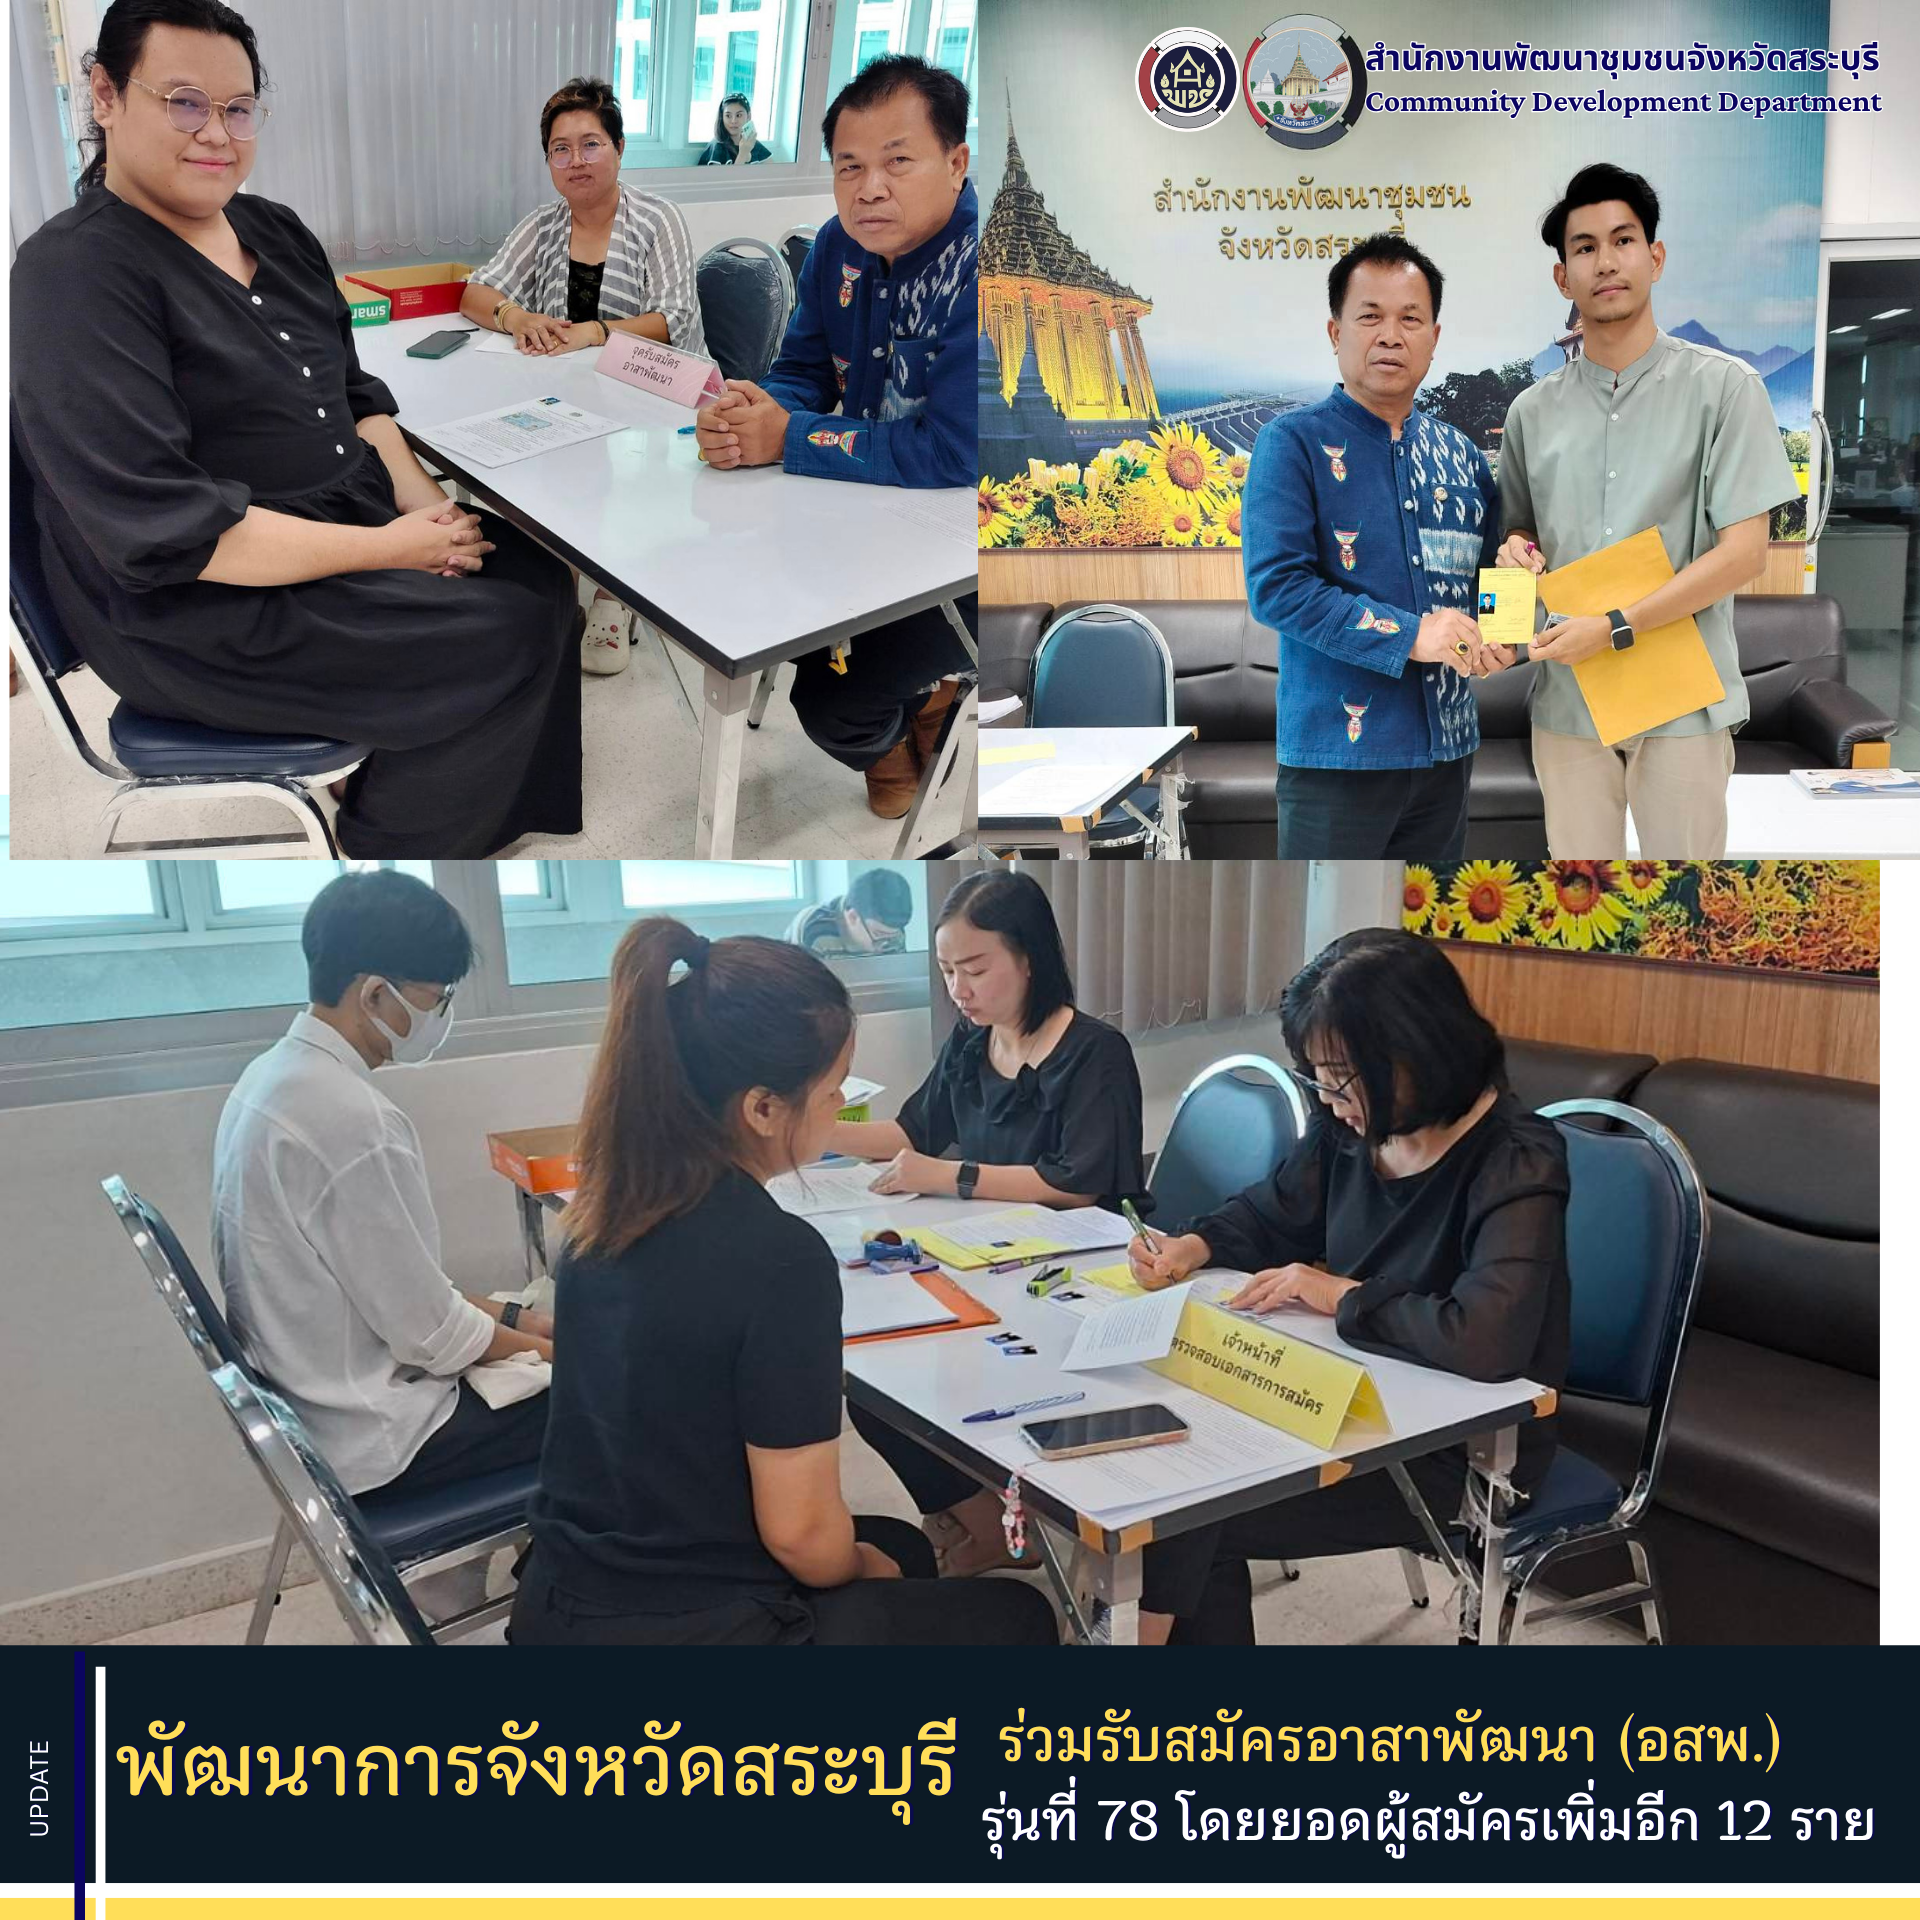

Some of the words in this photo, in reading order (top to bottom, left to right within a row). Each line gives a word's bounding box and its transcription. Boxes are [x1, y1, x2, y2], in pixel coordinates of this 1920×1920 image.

[1154, 176, 1472, 220] สำนักงานพัฒนาชุมชน
[622, 361, 673, 387] อาสาพัฒนา
[632, 346, 681, 370] จุดรับสมัคร
[1222, 1330, 1286, 1368] เจ้าหน้าที่
